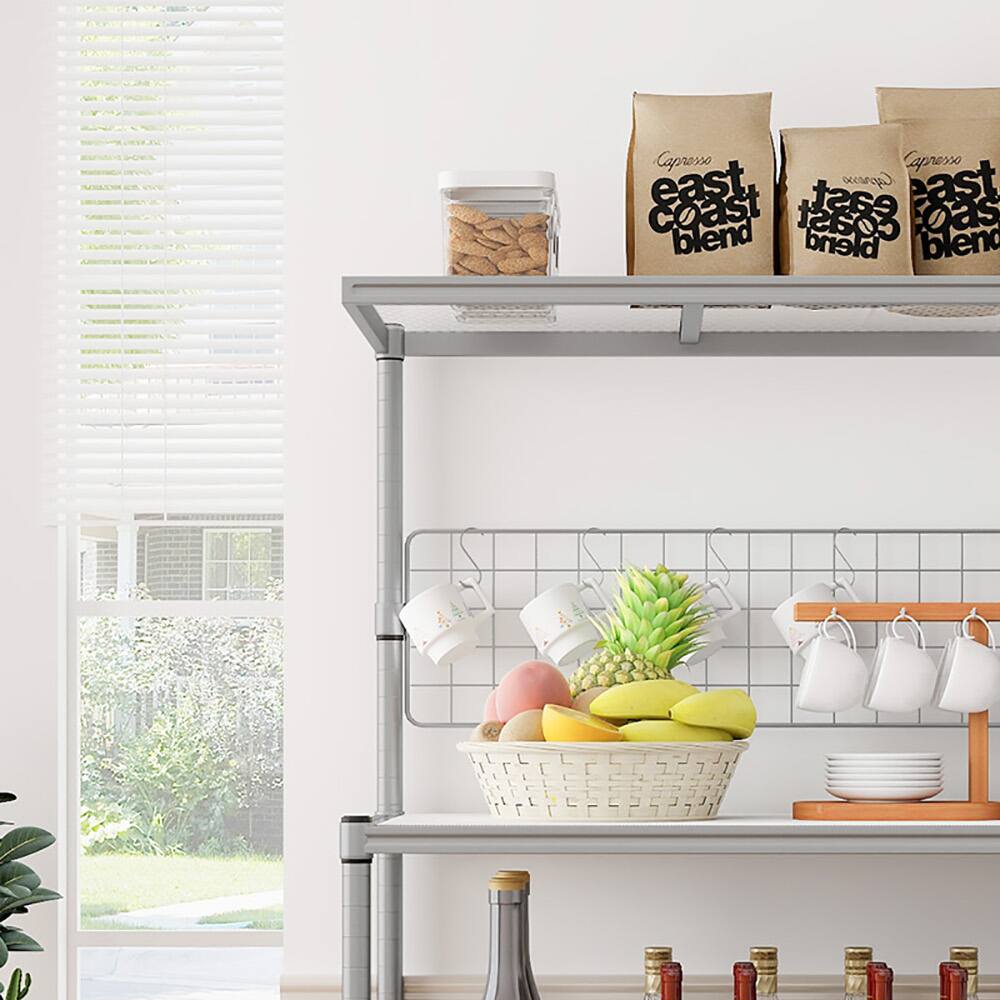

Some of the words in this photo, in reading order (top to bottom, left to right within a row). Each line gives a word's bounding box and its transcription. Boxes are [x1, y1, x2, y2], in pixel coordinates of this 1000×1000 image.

[656, 150, 712, 172] Capresso
[904, 150, 962, 172] Capresso
[651, 160, 744, 206] east
[648, 184, 761, 233] coast
[672, 216, 752, 255] blend
